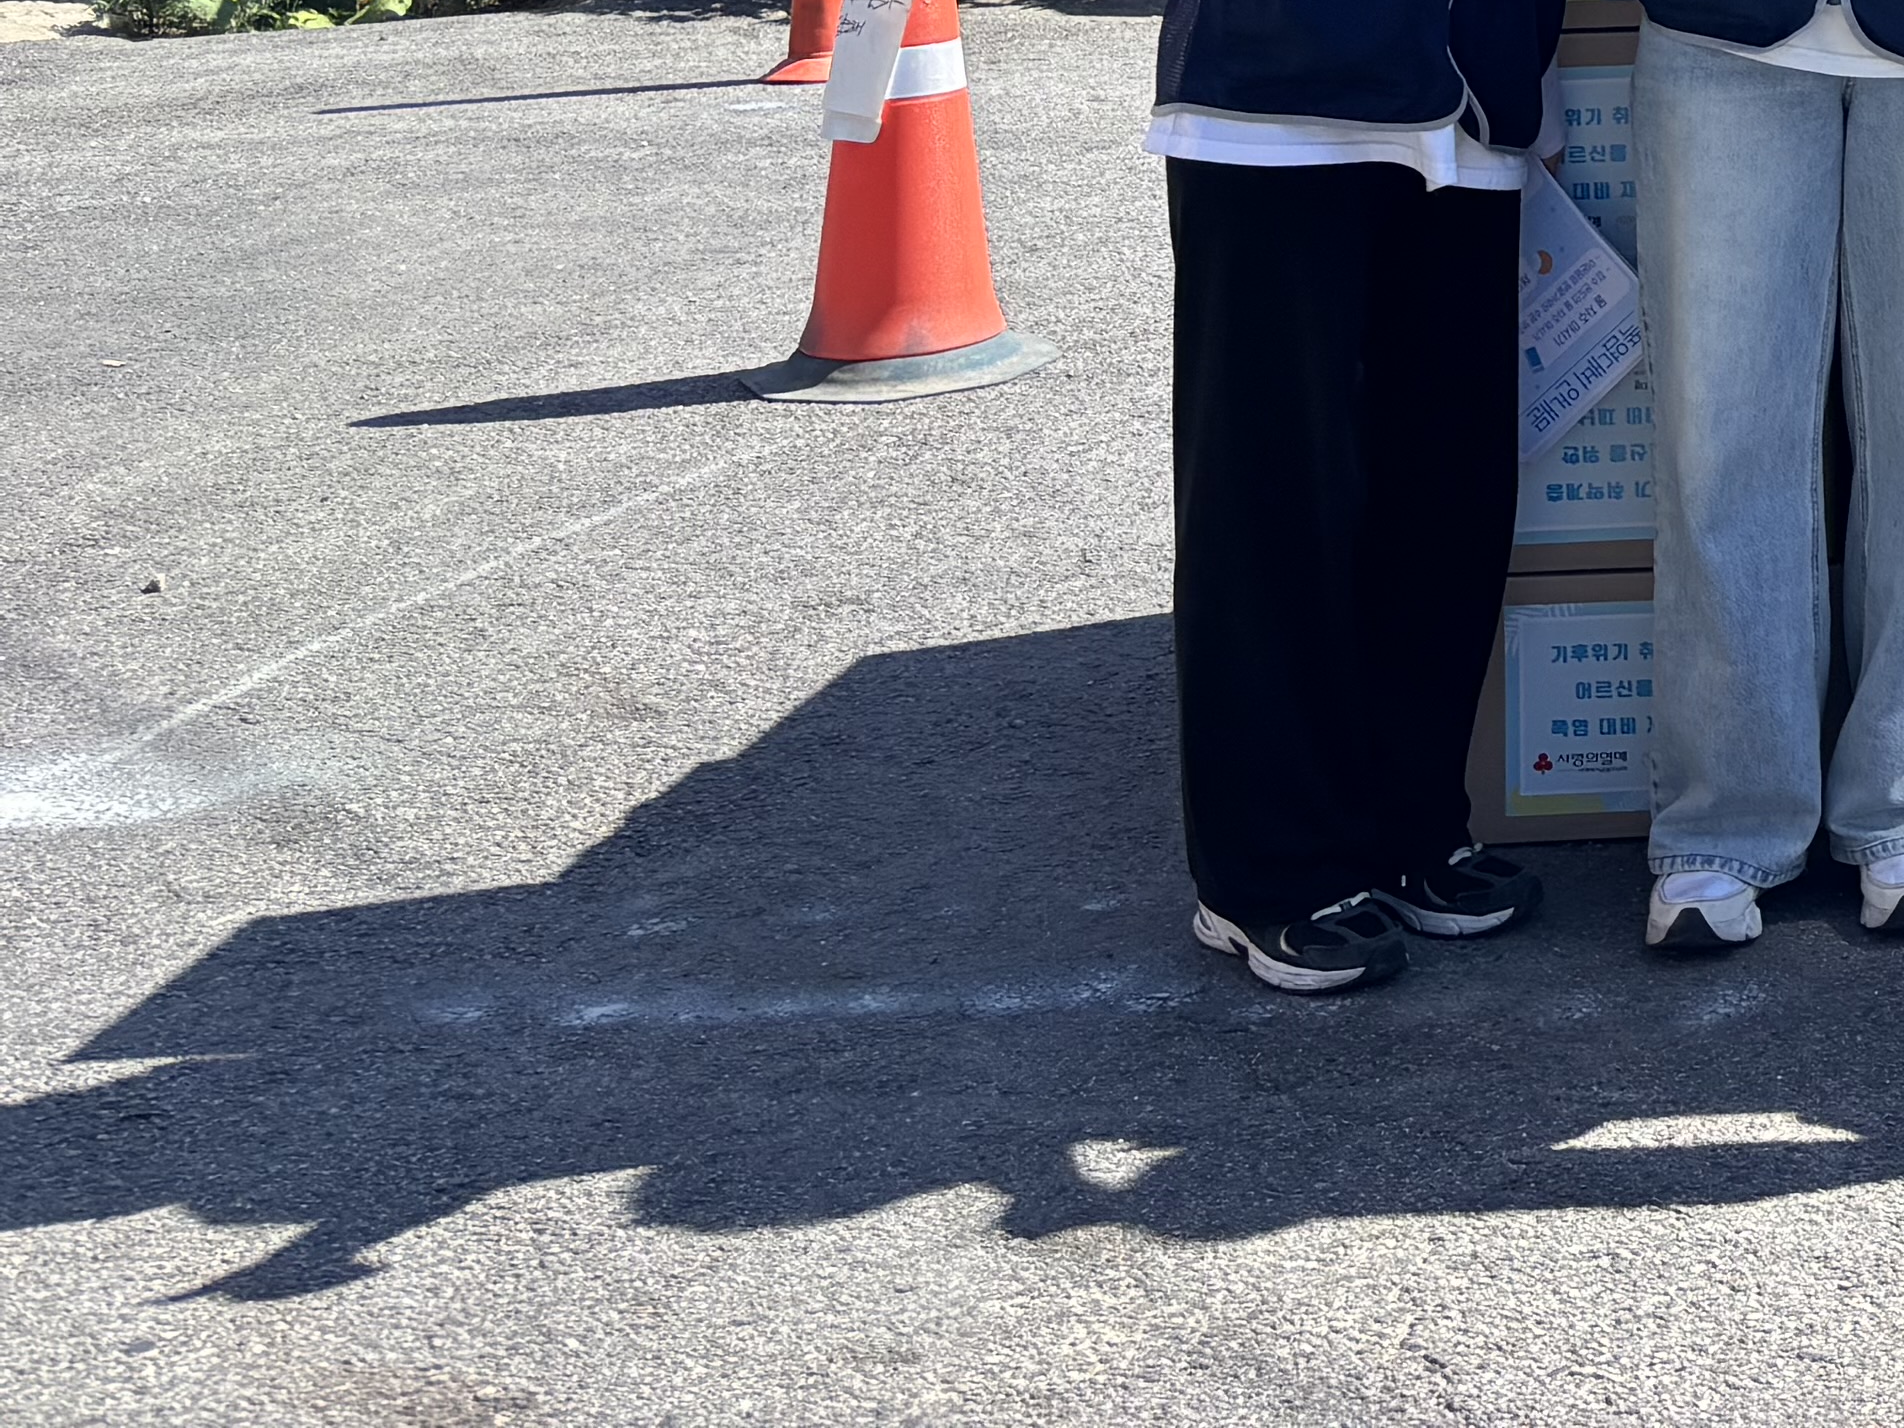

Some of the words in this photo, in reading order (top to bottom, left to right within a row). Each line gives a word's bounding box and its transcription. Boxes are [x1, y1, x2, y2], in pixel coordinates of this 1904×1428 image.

[1561, 144, 1627, 164] 르신을
[1526, 379, 1580, 433] 안내문
[1551, 642, 1628, 663] 기후위기
[1575, 678, 1653, 700] 어르신을
[1551, 718, 1589, 737] 폭염
[1599, 716, 1636, 736] 대비
